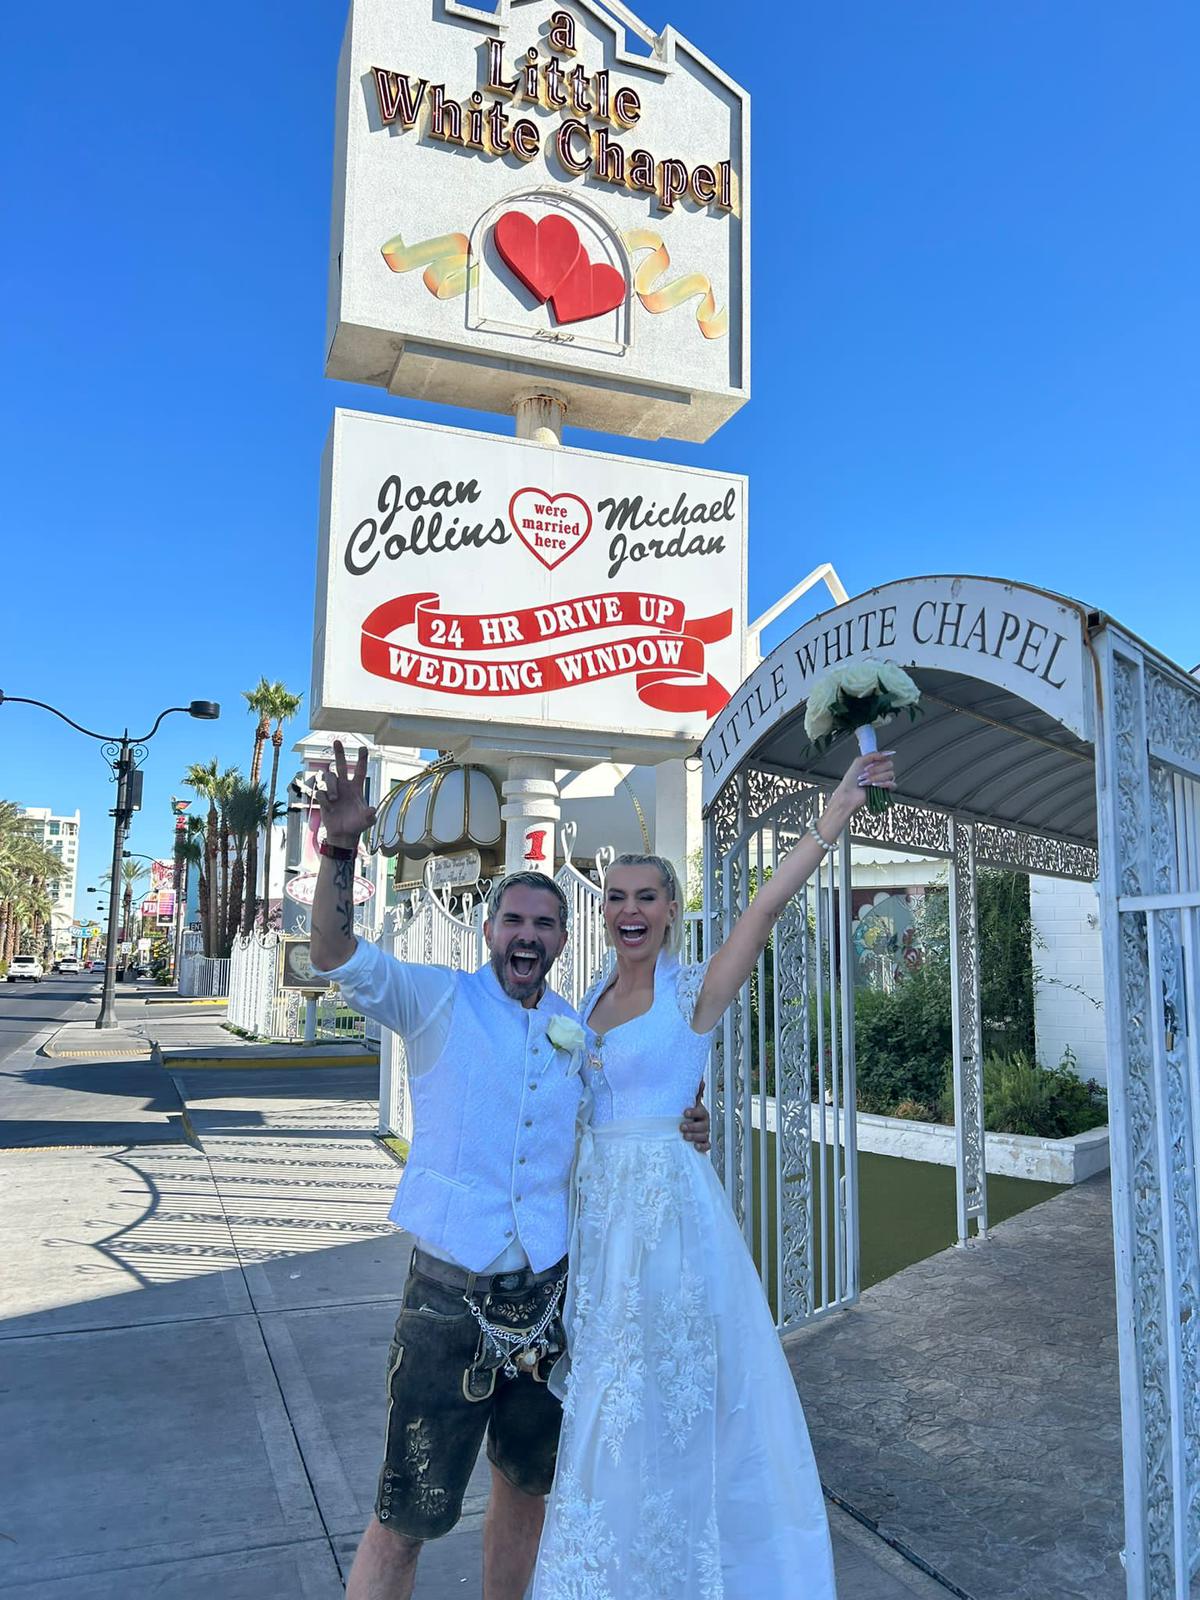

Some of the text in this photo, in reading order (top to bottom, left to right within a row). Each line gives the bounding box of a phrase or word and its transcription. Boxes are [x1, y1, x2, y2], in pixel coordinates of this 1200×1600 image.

[550, 10, 577, 55] a
[486, 37, 641, 128] Little
[371, 66, 732, 212] White Chapel
[377, 474, 481, 535] Joan
[522, 517, 580, 537] married
[534, 502, 568, 519] were
[597, 488, 736, 532] Michael
[344, 511, 512, 576] Collins
[534, 532, 567, 550] here
[607, 527, 726, 579] Jordan
[430, 596, 675, 649] 24 HR DRIVE UP
[388, 639, 684, 692] WEDDING WINDOW
[705, 600, 1069, 775] LITTLE WHITE CHAPEL
[524, 830, 547, 860] 1
